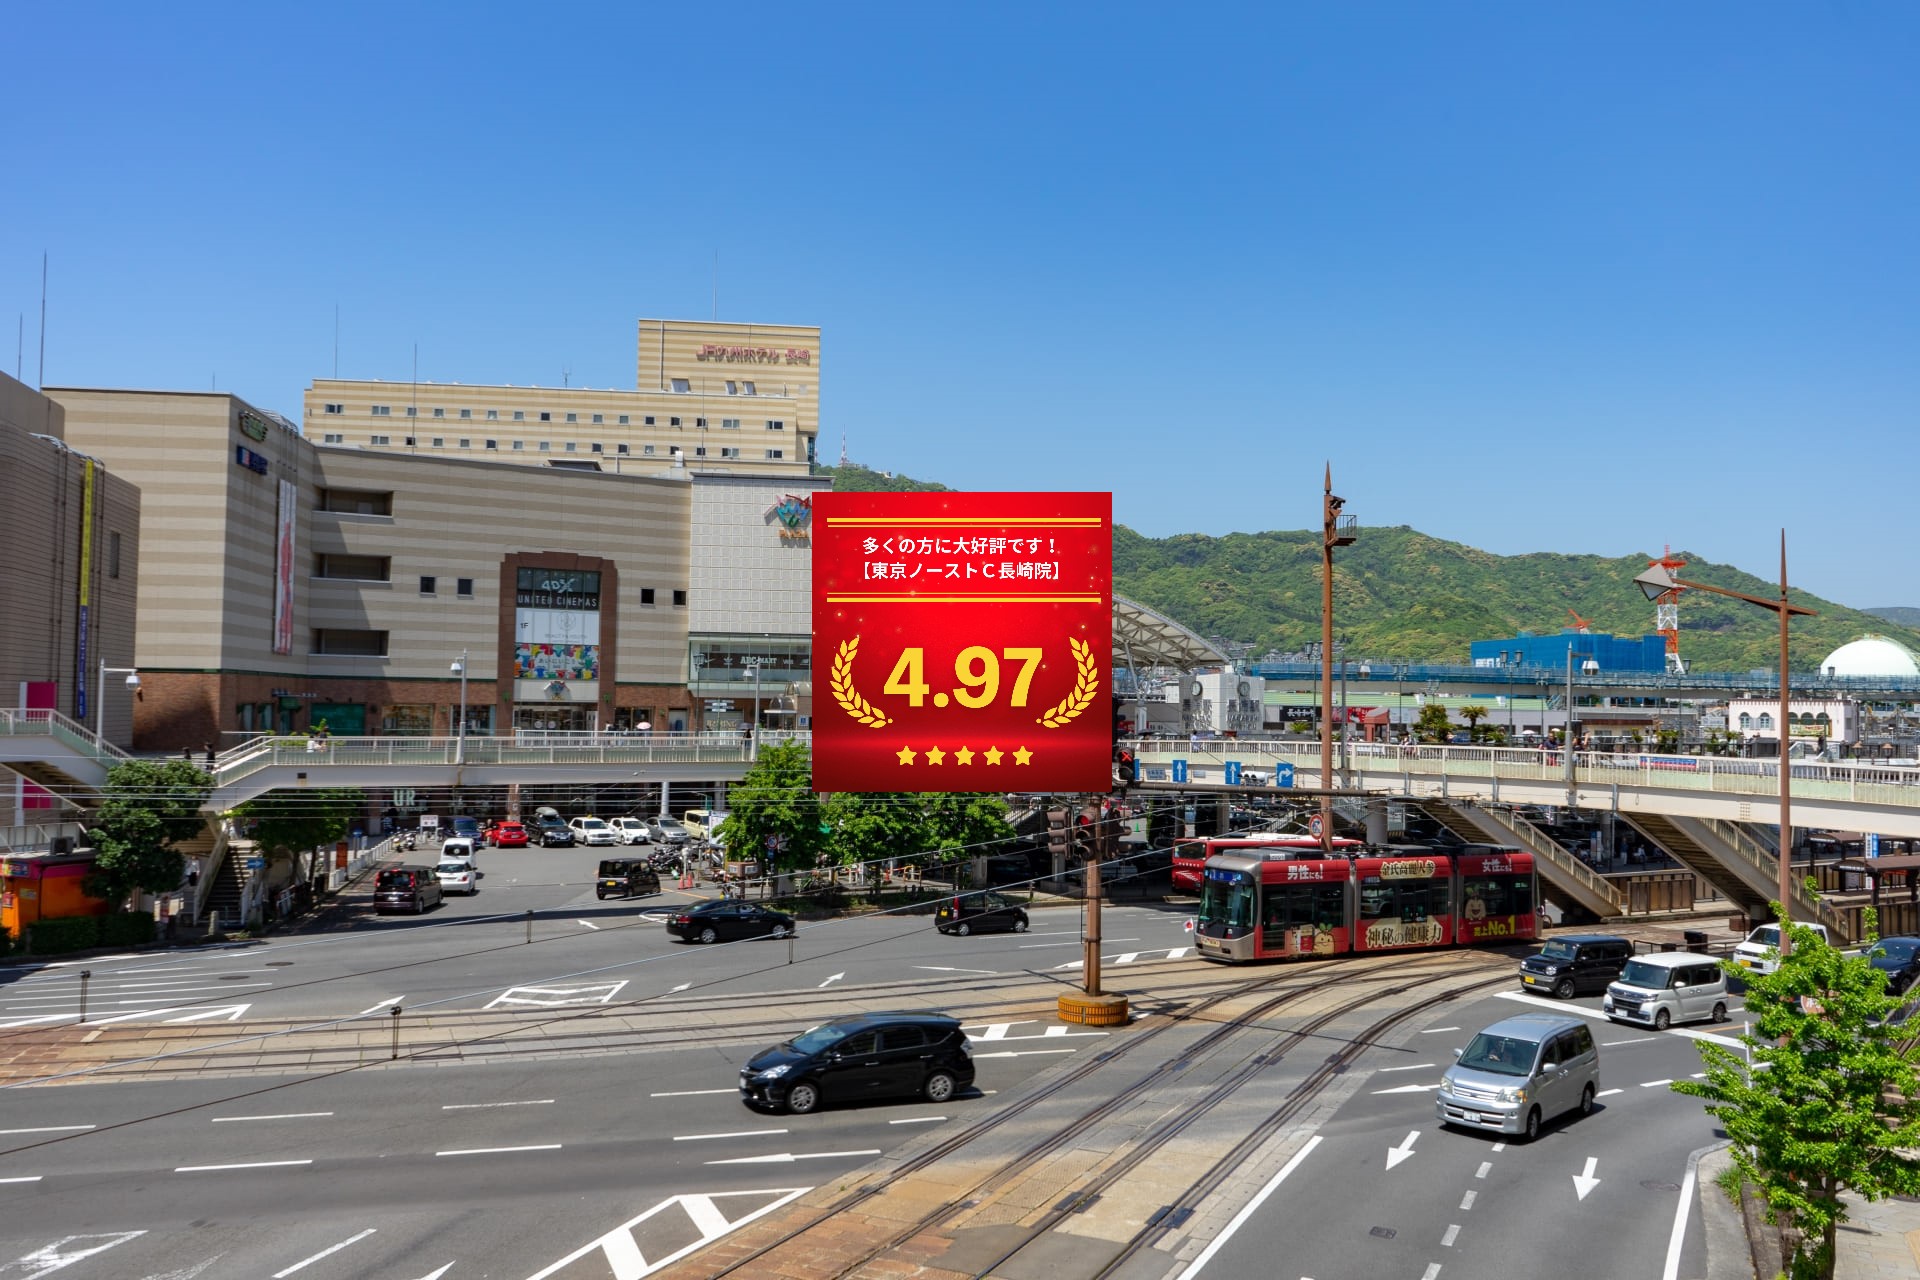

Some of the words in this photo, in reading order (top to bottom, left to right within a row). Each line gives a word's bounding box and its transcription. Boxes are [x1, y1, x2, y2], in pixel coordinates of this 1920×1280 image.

[541, 578, 576, 593] 4DX
[517, 594, 553, 606] UNITED
[556, 596, 598, 607] CINEMAS
[1287, 863, 1324, 881] 男性にも！
[1367, 925, 1442, 948] 神秘の健康力
